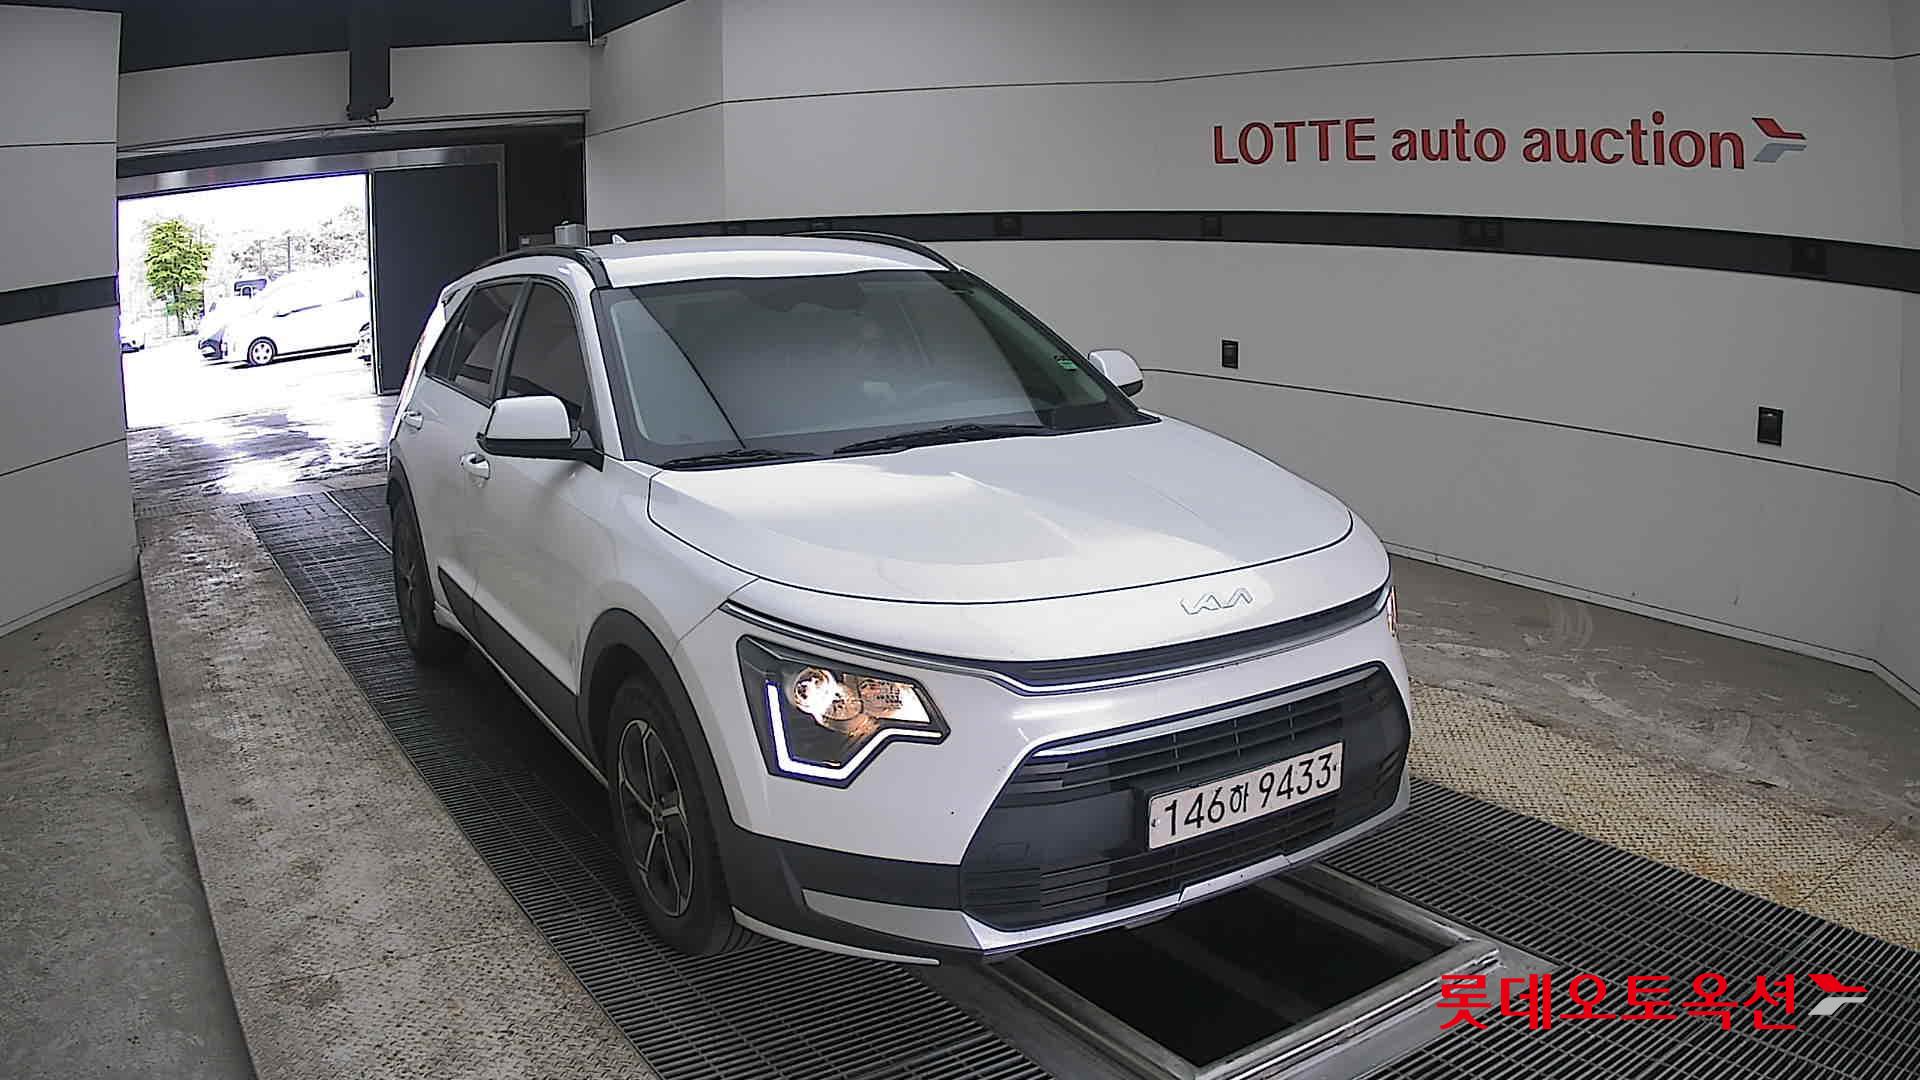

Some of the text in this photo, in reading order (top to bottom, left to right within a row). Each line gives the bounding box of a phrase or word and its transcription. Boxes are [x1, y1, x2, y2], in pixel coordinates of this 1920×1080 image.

[1213, 111, 1745, 170] LOTTE auto auction
[1259, 752, 1334, 808] 9433
